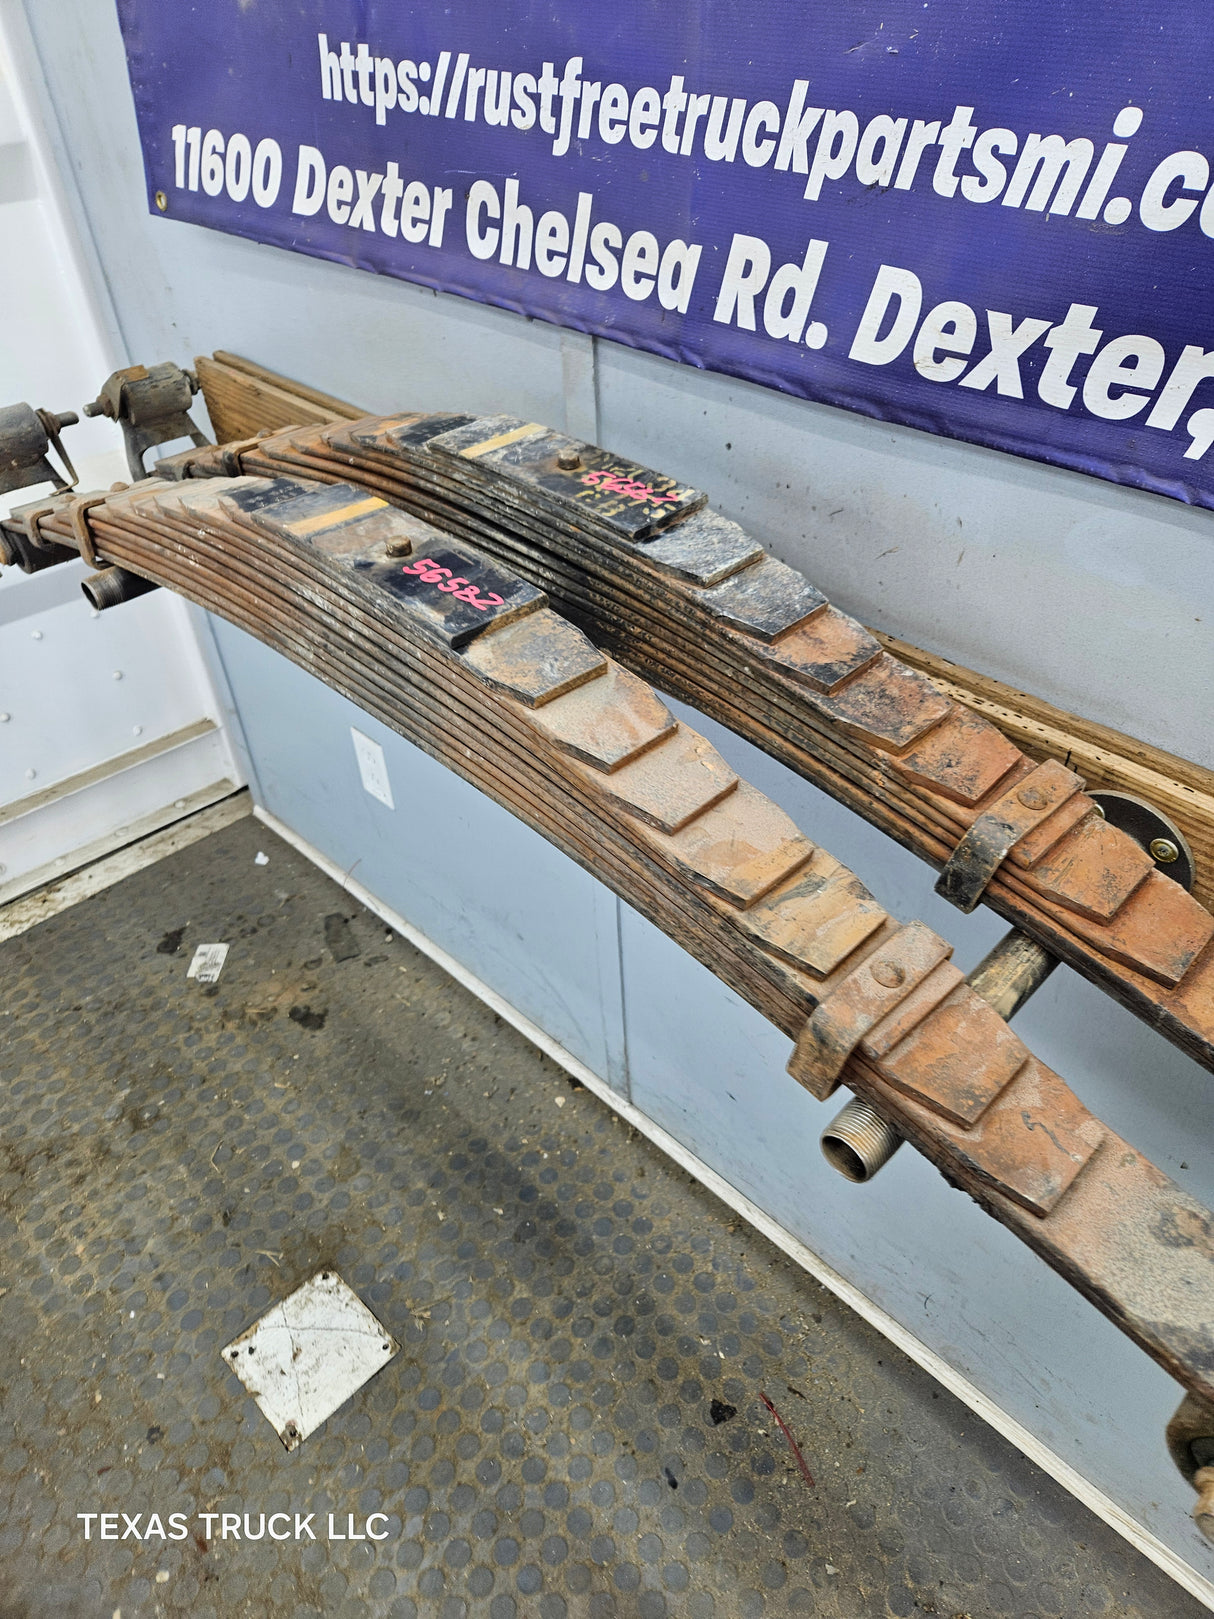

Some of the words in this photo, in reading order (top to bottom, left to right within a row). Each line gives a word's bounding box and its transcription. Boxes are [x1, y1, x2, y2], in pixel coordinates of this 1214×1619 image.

[317, 33, 1214, 239] https://rustfreetruckpartsmi.c
[171, 124, 283, 209] 11600
[292, 144, 453, 248] Dexter
[465, 178, 703, 315] Chelsea
[713, 233, 829, 350] Rd.
[848, 264, 1214, 461] Dexter,
[402, 558, 504, 611] 56582
